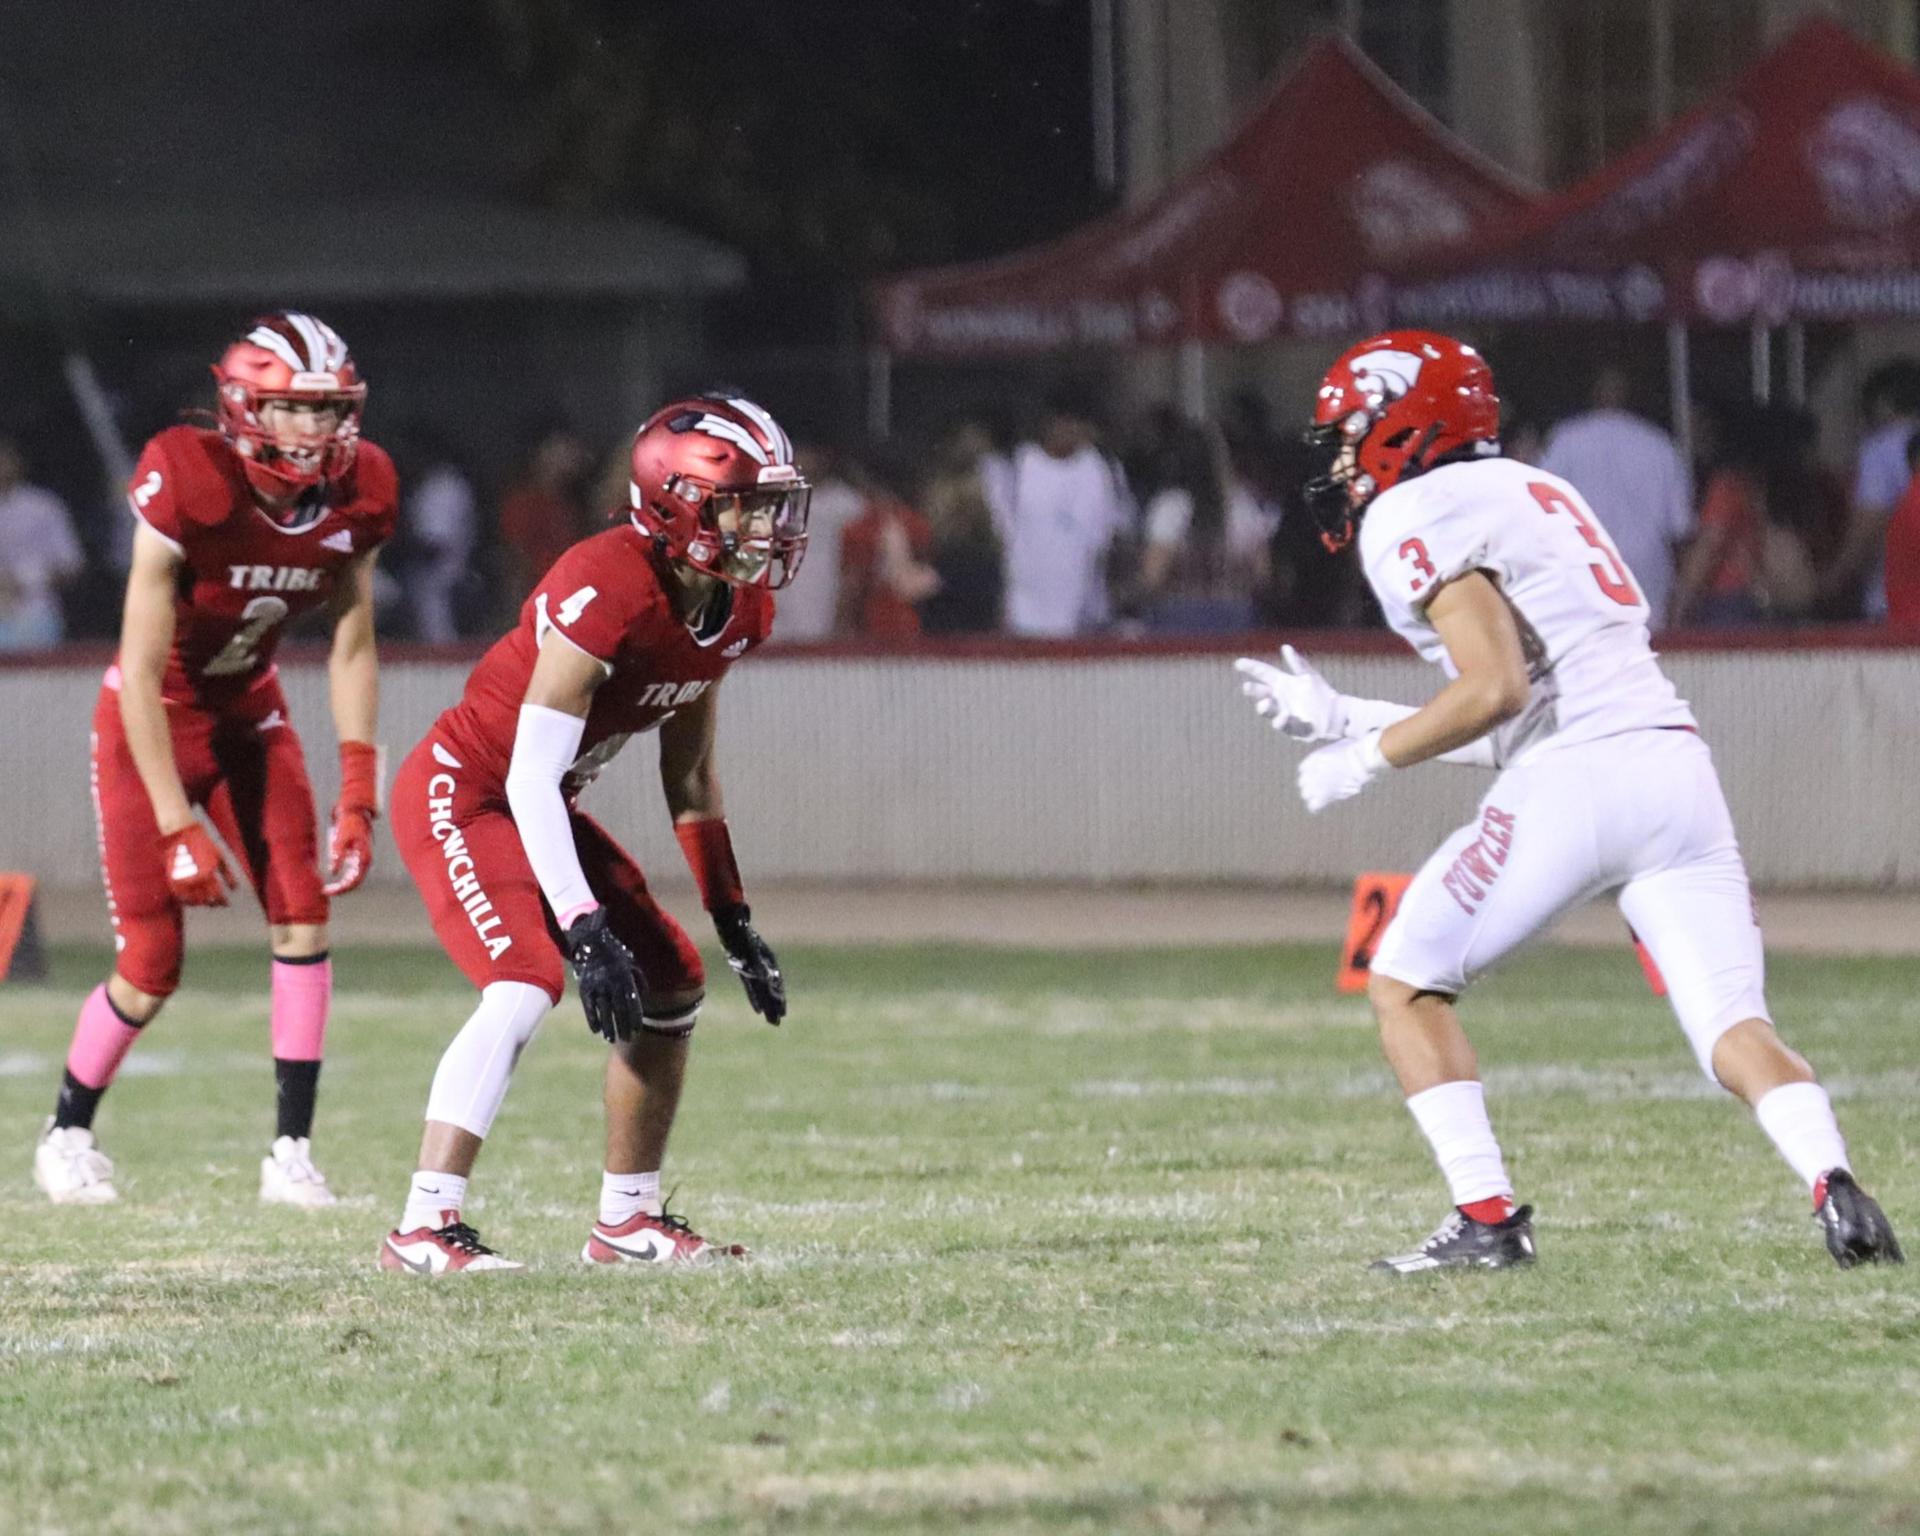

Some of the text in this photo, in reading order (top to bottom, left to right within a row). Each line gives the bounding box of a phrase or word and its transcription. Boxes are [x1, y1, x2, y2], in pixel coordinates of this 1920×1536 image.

[134, 471, 163, 507] 2
[1399, 537, 1437, 591] 3
[1527, 481, 1641, 607] 3
[202, 595, 289, 676] 2
[556, 585, 598, 627] 4
[428, 773, 513, 961] CHOWCHILLA
[1442, 805, 1516, 917] FOWLER
